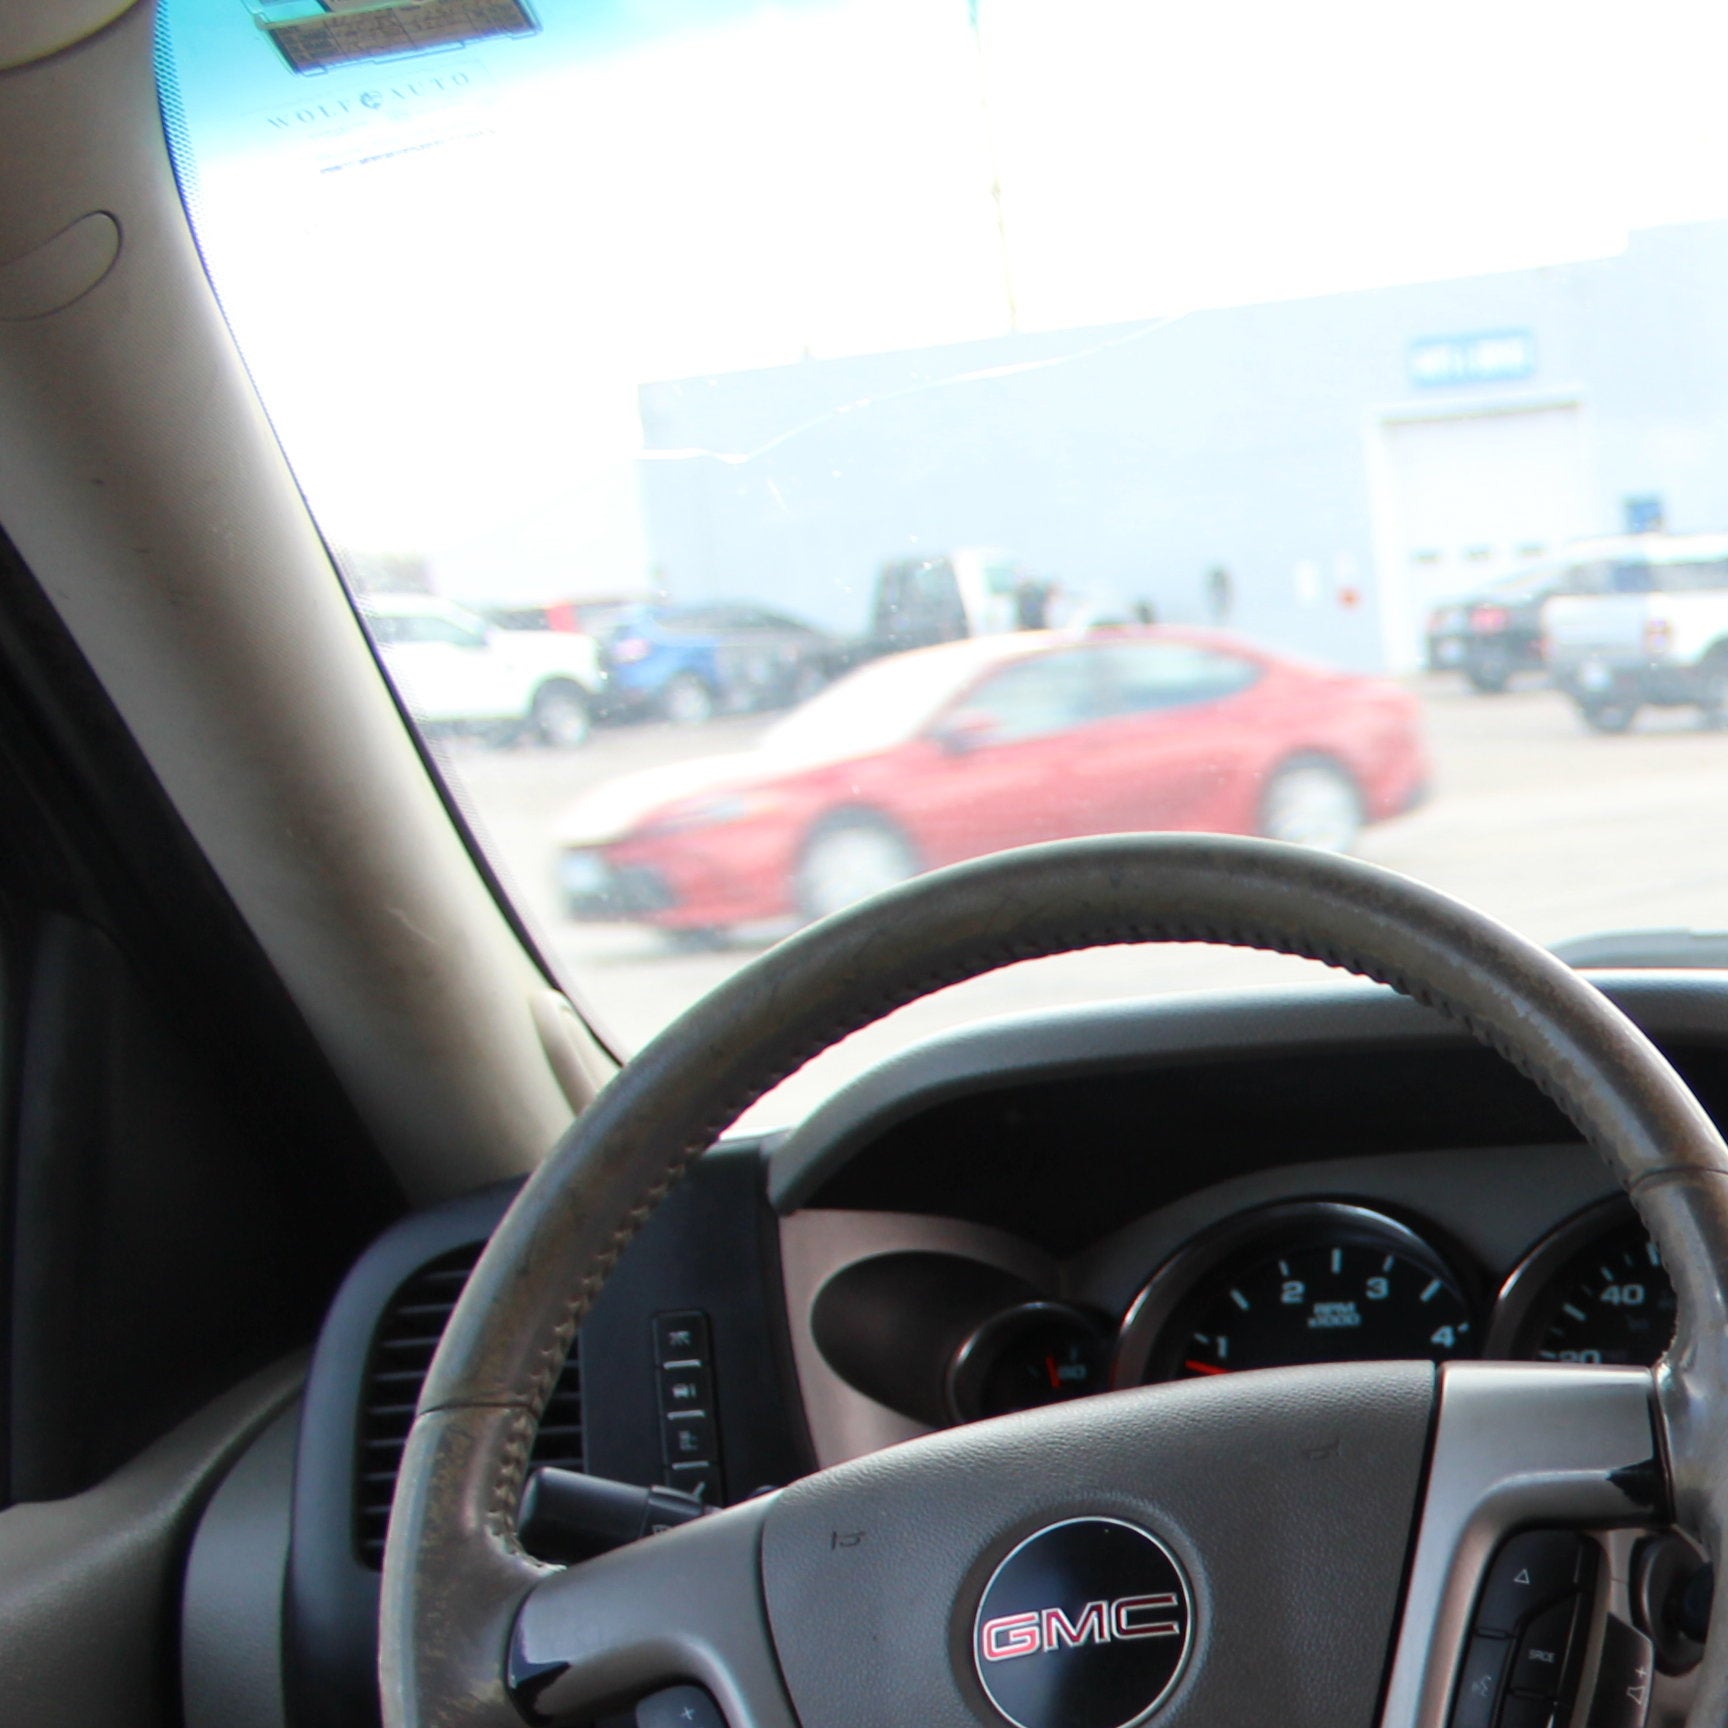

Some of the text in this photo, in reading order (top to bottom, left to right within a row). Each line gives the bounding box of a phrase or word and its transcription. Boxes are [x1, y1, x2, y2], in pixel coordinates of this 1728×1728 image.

[1281, 1279, 1305, 1304] 2
[1366, 1276, 1390, 1300] 3
[1599, 1282, 1646, 1307] 40
[1214, 1335, 1229, 1358] 1
[1430, 1325, 1456, 1349] 4
[982, 1592, 1180, 1662] GMC
